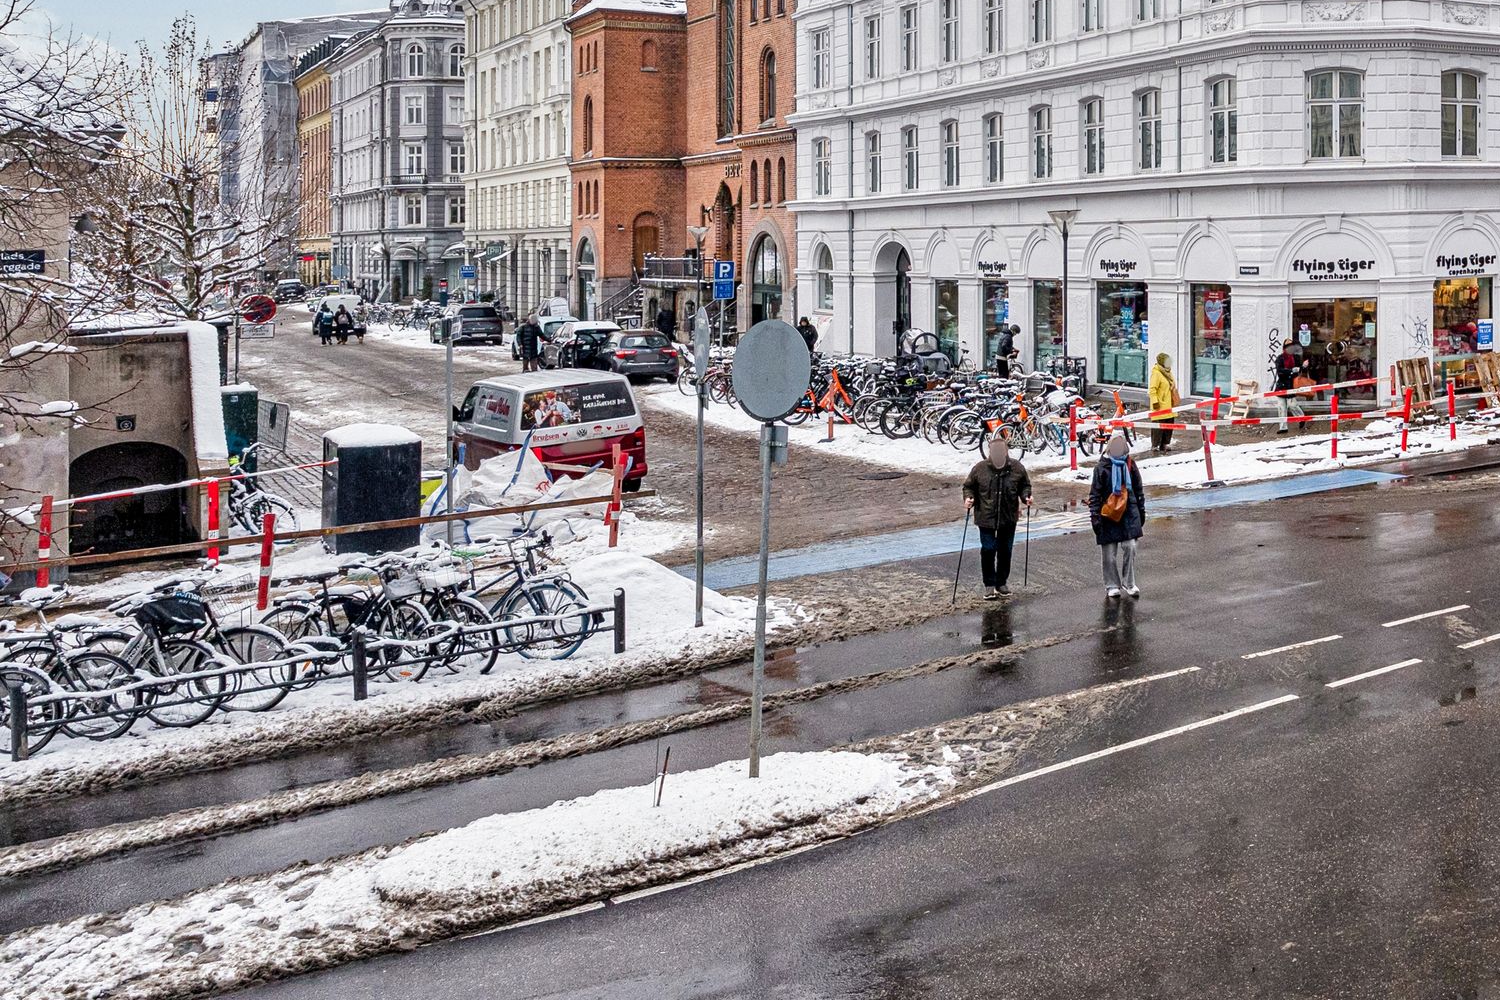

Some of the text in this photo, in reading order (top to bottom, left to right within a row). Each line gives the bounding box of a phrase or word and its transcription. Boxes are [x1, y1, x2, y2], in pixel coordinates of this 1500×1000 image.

[1100, 259, 1119, 272] flying
[1292, 258, 1376, 274] flying tiger
[1436, 253, 1497, 269] flying tiger
[720, 263, 731, 278] P
[1309, 273, 1359, 281] copenhagen
[1449, 268, 1485, 276] copenhagen
[533, 433, 560, 442] Brugsen
